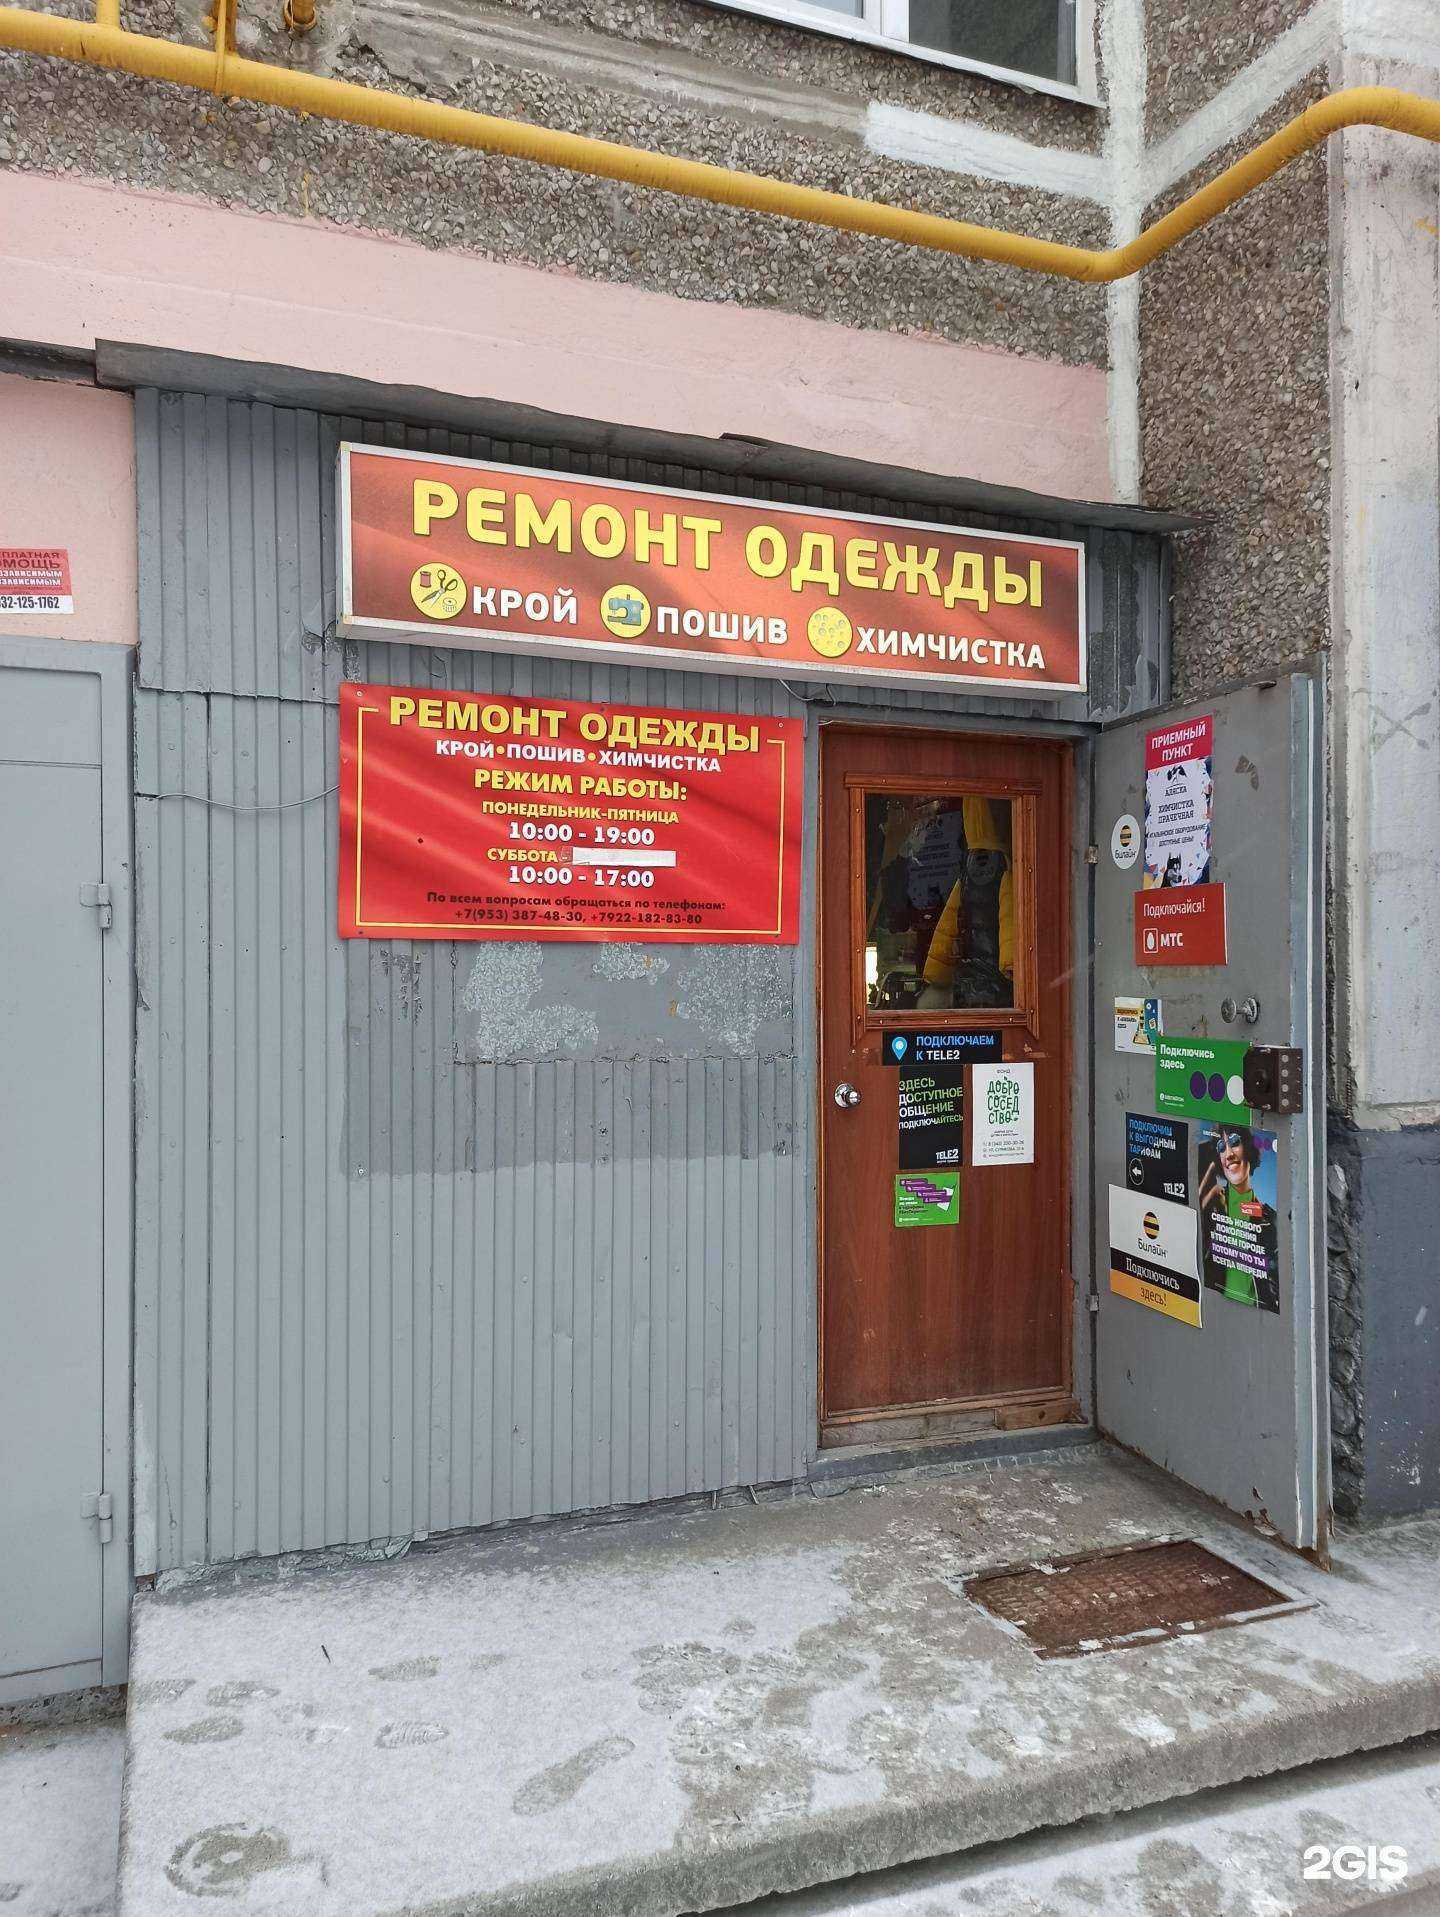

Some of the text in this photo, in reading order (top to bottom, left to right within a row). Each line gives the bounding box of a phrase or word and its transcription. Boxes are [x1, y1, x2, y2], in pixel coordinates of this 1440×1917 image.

[412, 478, 1043, 613] РЕМОНТ ОДЕЖДЫ
[0, 551, 60, 559] ПЛАТНАЯ
[0, 596, 60, 608] 32-125-1762
[471, 585, 1046, 669] КРОЙ ПОШИВ ХИМЧИСТКА
[389, 696, 760, 756] РЕМОНТ ОДЕЖДЫ
[1151, 721, 1207, 749] ПРИЕМНЫЙ
[436, 739, 722, 772] КРОЙ ПОШИВ ХИМЧИСТКА
[1162, 743, 1193, 761] ПУНКТ
[475, 768, 688, 801] РЕЖИМ РАБОТЫ:
[482, 801, 680, 824] ПОНЕДЕЛЬНИК-ПЯТНИЦА
[1158, 800, 1194, 813] ХИМЧИСТКА
[1158, 810, 1194, 824] ПРАЧЕЧНАЯ
[509, 822, 573, 842] 10:00
[594, 826, 655, 845] 19:00
[487, 847, 558, 863] СУББОТА
[508, 866, 573, 885] 10:00
[594, 869, 655, 887] 17:00
[427, 892, 726, 911] По всем вопросам обращаться по телефонам:
[1143, 898, 1206, 918] Подключайся!
[456, 908, 702, 924] +7(953) 387-48-30, +7922-182-83-80
[1160, 933, 1184, 947] МТС
[916, 1036, 994, 1047] ПОДКЛЮЧАЕМ
[916, 1050, 960, 1060] К TELE2
[1160, 1044, 1215, 1059] Подключись
[1160, 1059, 1185, 1070] здесь
[899, 1077, 935, 1092] ЗДЕСЬ
[987, 1079, 1020, 1096] ДОБРО
[899, 1087, 964, 1106] ДОСТУПНОЕ
[987, 1095, 1020, 1115] СОСЕД
[899, 1101, 954, 1118] ОБЩЕНИЕ
[899, 1114, 964, 1130] ПОДКЛЮЧАЙТЕСЬ
[1129, 1119, 1173, 1136] ПОДКЛЮЧИМ
[1135, 1133, 1176, 1150] ВЫГОДНЫМ
[935, 1148, 959, 1160] TELE2
[1163, 1182, 1186, 1198] TELE2
[1234, 1218, 1262, 1233] НОВОГО
[1212, 1243, 1266, 1267] ПОТОМУ ЧТО ТЫ
[1239, 1239, 1266, 1255] ГОРОДЕ
[1126, 1257, 1180, 1290] Подключись
[1140, 1287, 1167, 1306] здесь!
